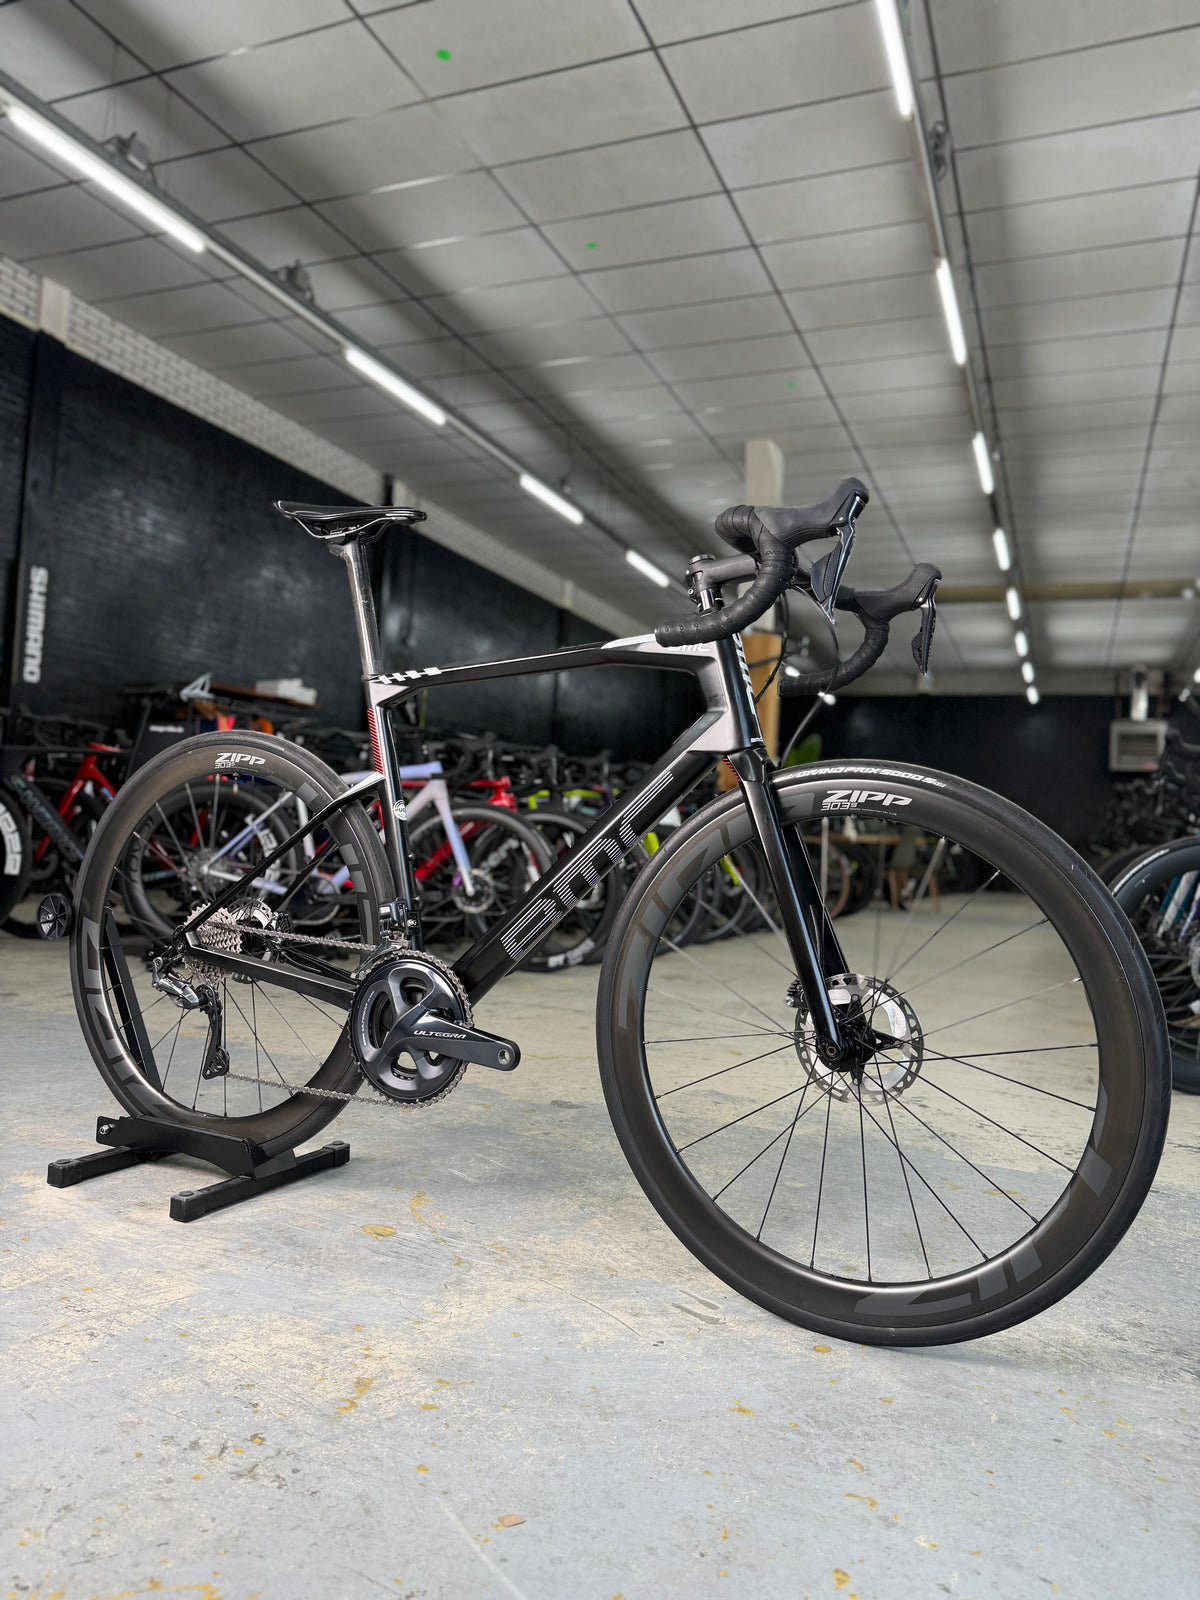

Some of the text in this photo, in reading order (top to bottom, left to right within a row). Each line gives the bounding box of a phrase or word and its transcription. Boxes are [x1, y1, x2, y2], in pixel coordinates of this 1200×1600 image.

[22, 565, 49, 684] SHIMANO
[215, 752, 266, 765] ZIPP
[797, 766, 844, 778] GRAND
[844, 766, 881, 774] PRIX
[879, 768, 924, 781] 5000
[823, 790, 913, 806] ZIPP
[413, 1029, 467, 1039] ULTEGRA
